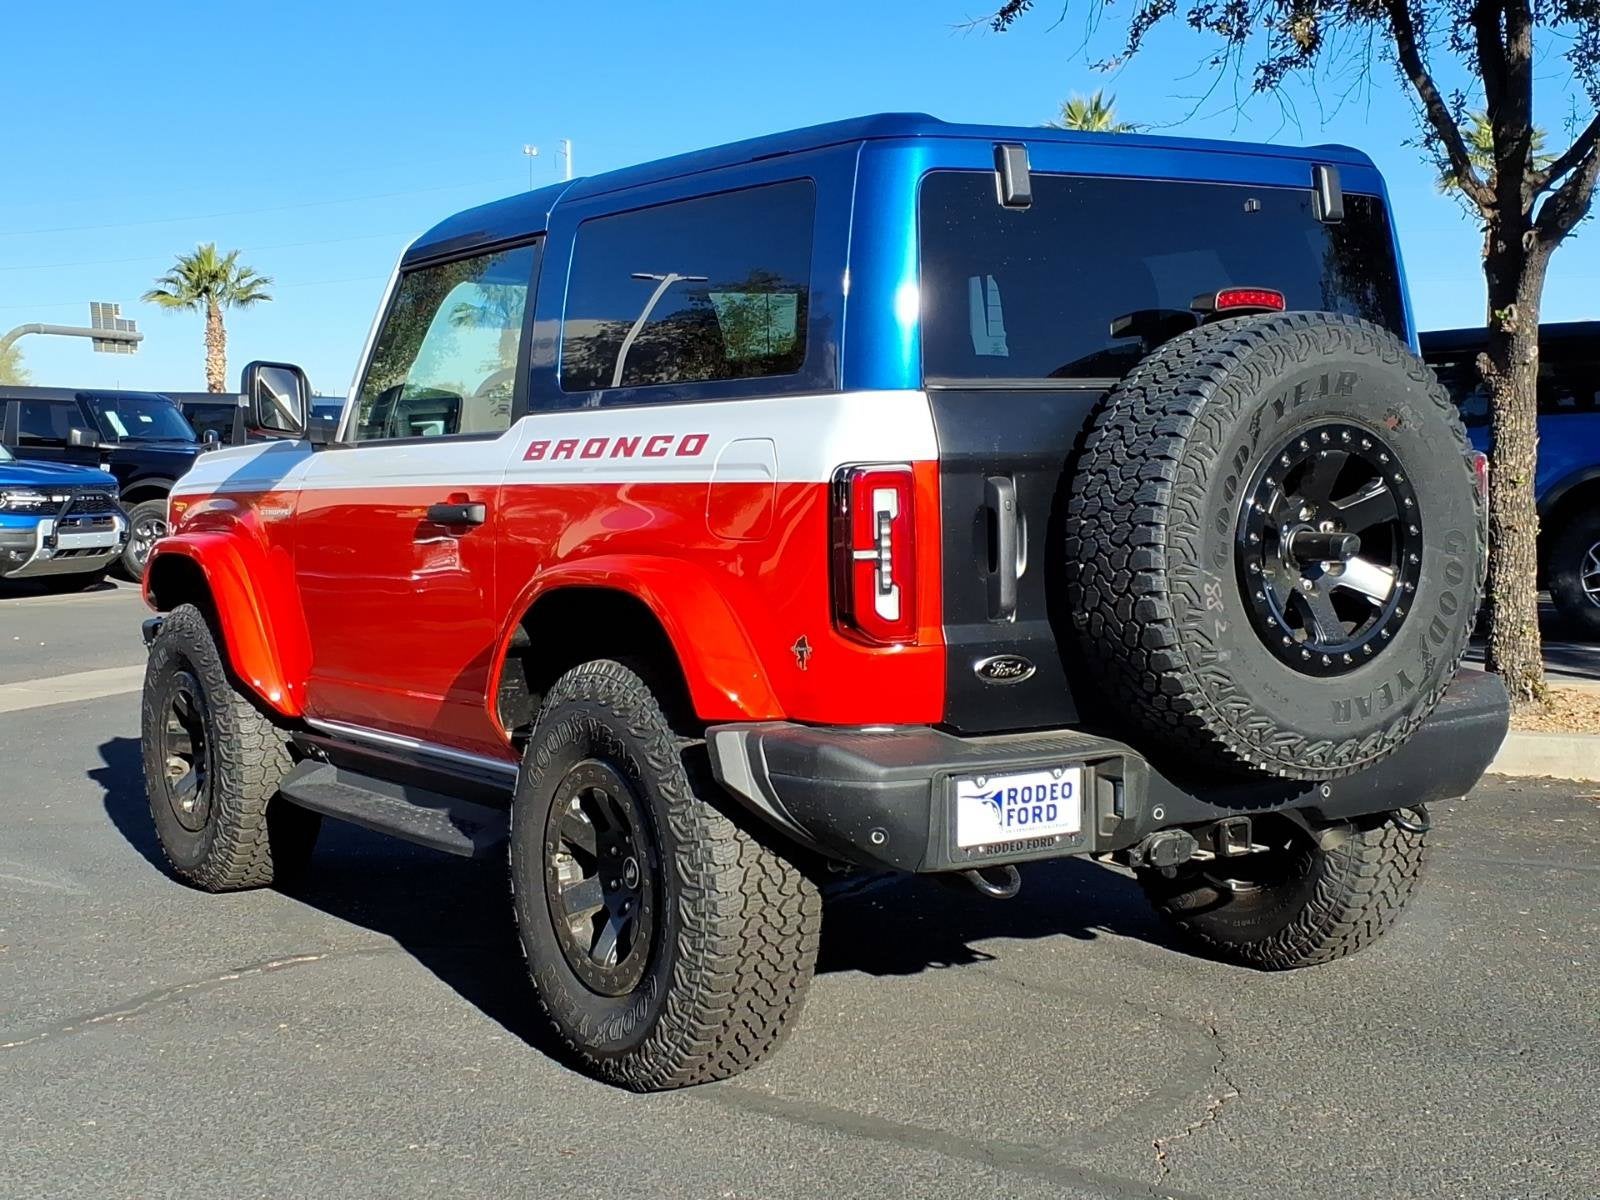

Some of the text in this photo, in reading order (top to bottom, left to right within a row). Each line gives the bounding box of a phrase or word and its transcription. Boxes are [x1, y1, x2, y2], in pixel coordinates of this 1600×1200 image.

[522, 433, 710, 462] BRONCO
[990, 660, 1022, 677] Ford
[1007, 782, 1073, 806] RODEO
[1007, 804, 1058, 827] FORD
[986, 837, 1055, 855] RODEO FORD
